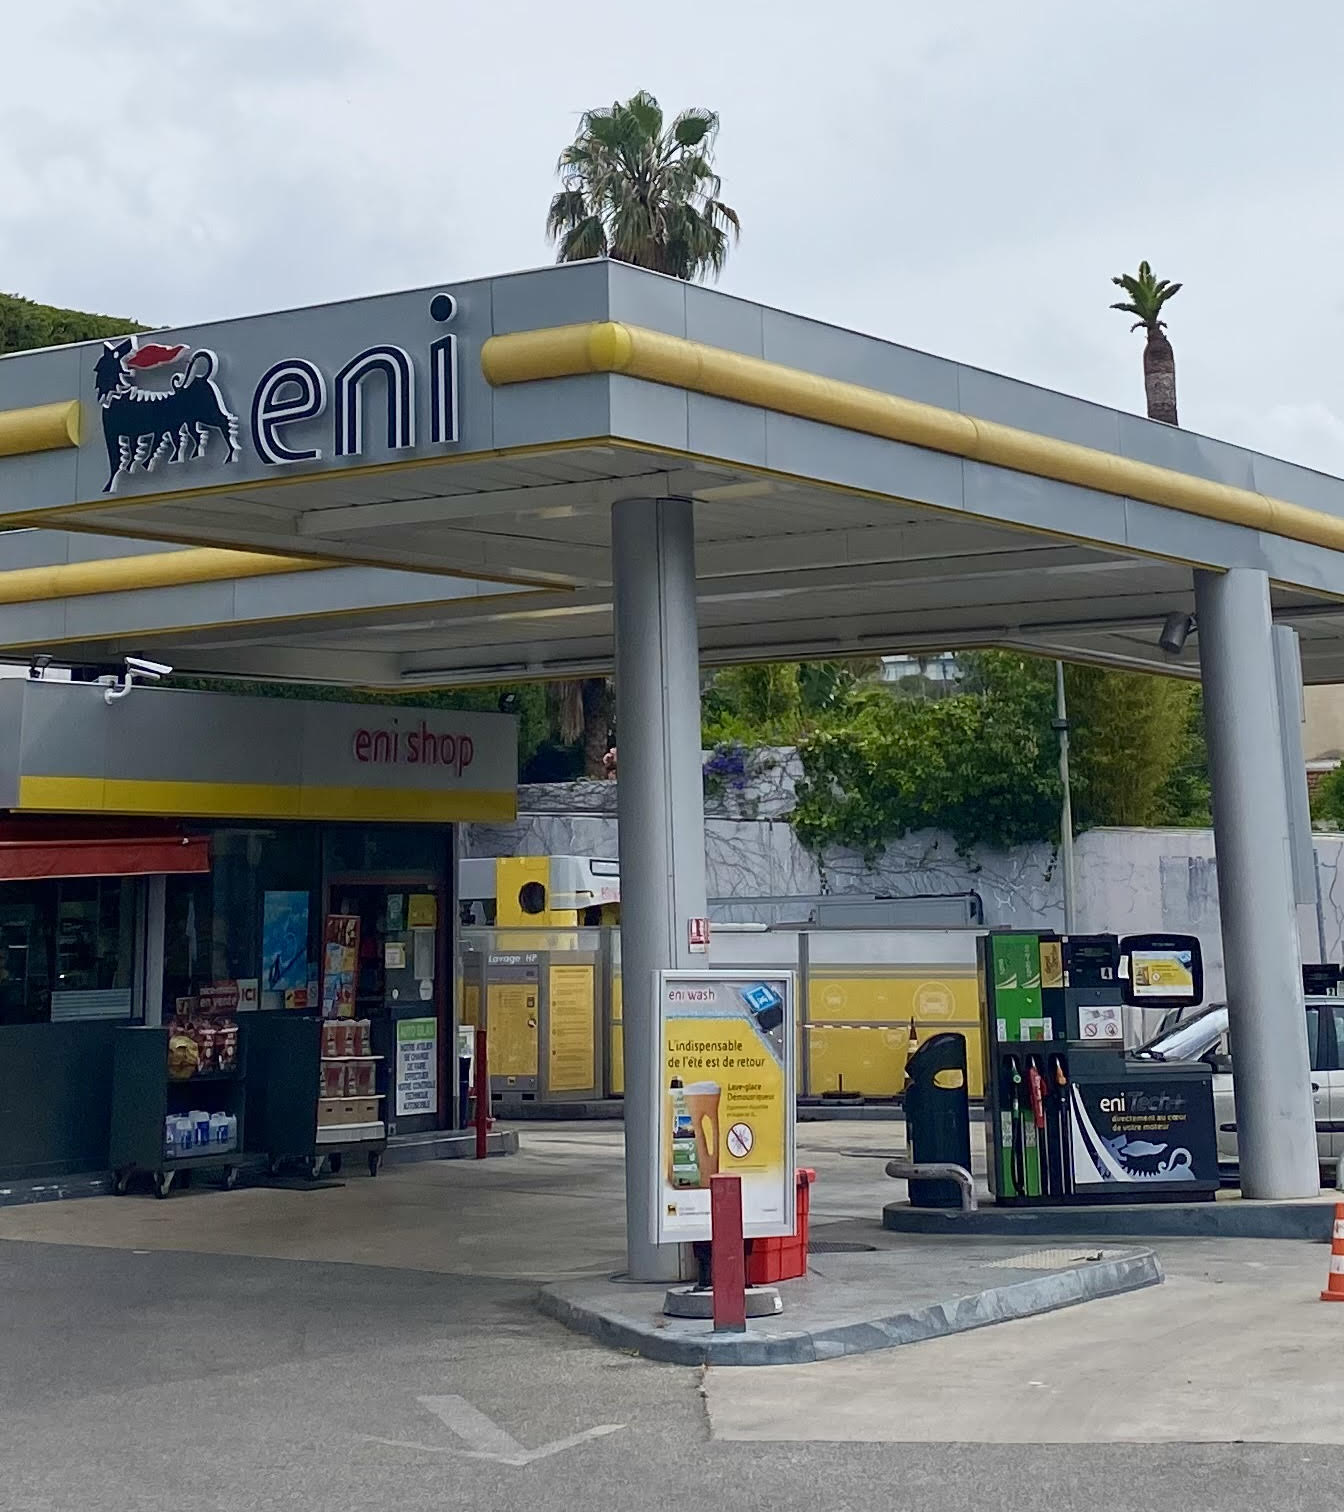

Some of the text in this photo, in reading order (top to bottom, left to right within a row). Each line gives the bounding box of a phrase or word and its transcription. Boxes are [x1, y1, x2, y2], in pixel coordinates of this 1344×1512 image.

[251, 292, 459, 466] eni
[353, 718, 474, 777] eni shop
[668, 988, 716, 1001] eni wash
[667, 1039, 744, 1052] L'indispensable
[667, 1057, 681, 1068] de
[705, 1058, 720, 1068] est
[722, 1055, 735, 1068] de
[736, 1057, 766, 1068] retour
[1099, 1091, 1126, 1112] eni
